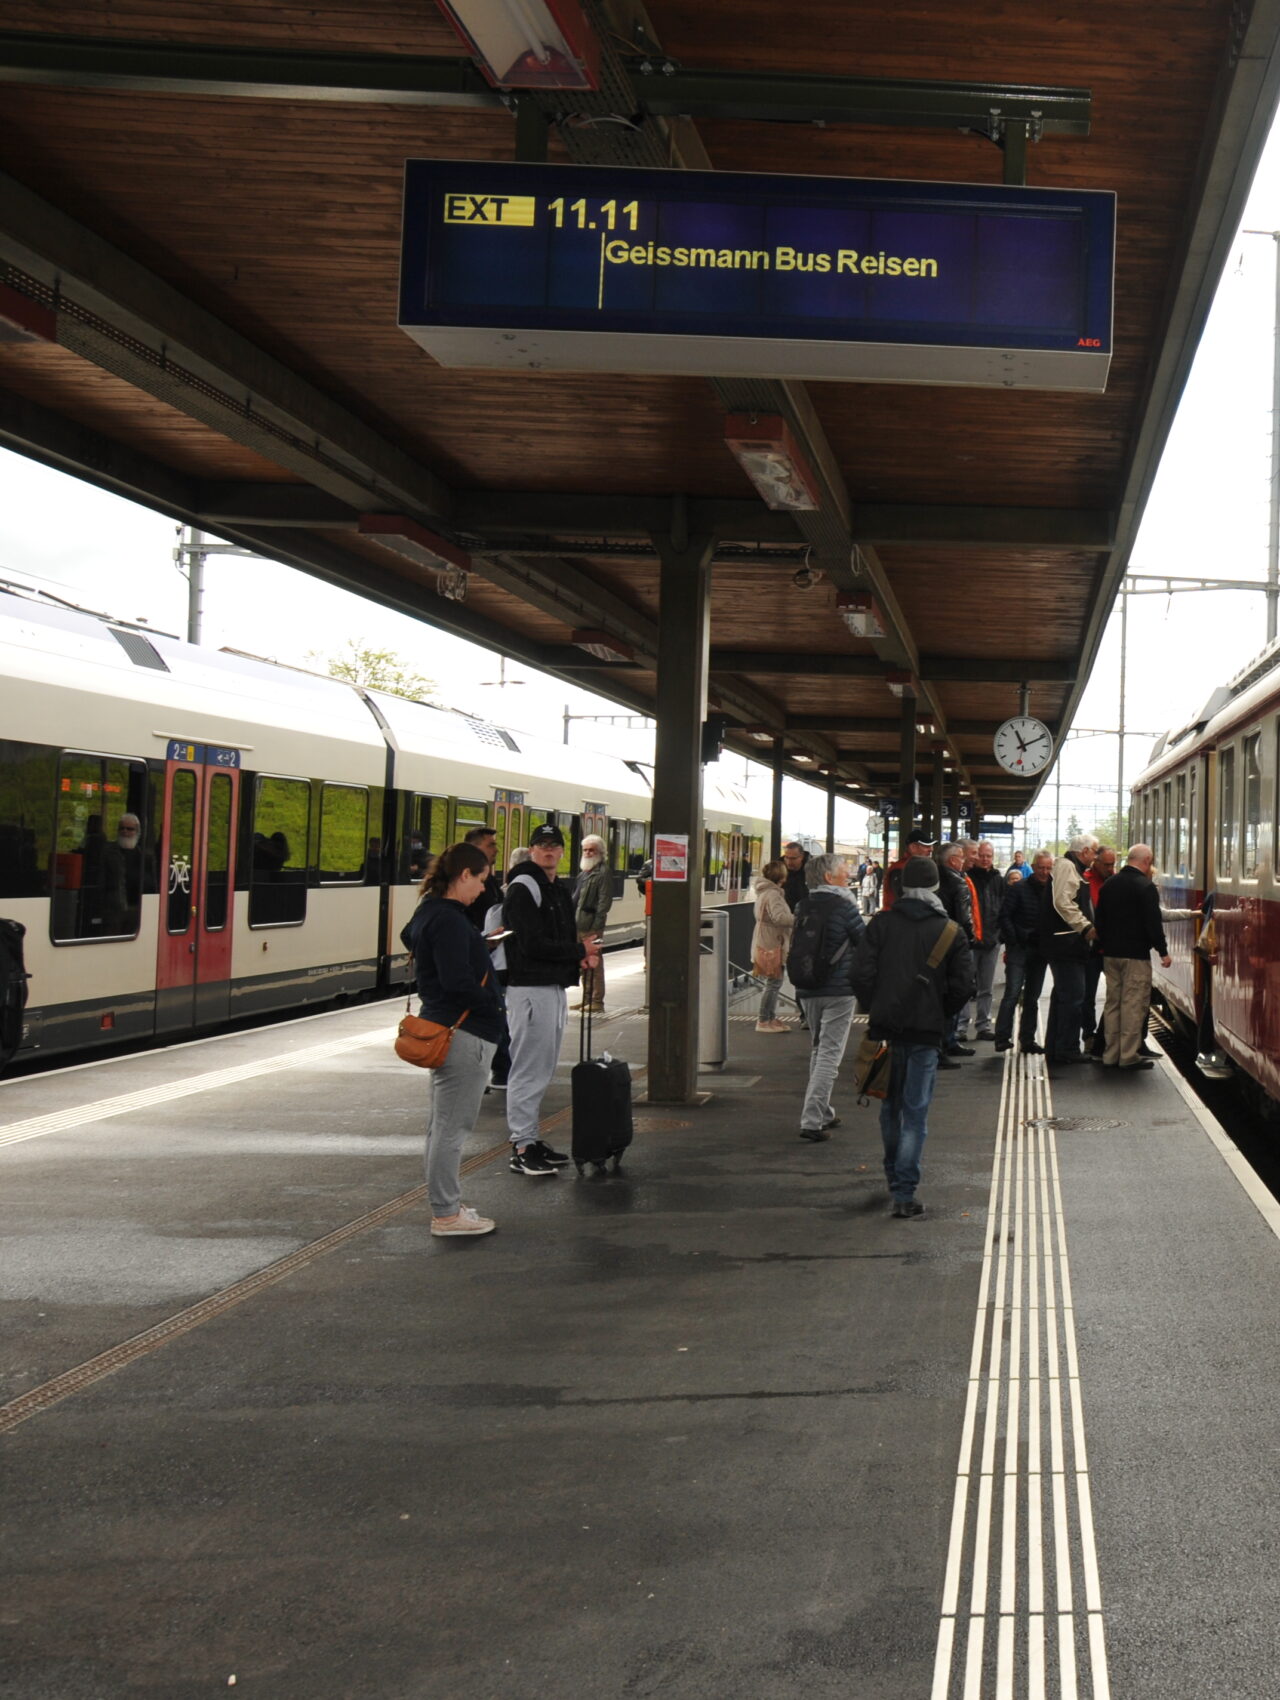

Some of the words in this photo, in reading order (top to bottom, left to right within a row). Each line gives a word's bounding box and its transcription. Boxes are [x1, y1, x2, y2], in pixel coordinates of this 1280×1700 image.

[447, 195, 509, 221] EXT
[548, 197, 639, 231] 11.11
[605, 239, 770, 270] Geissmann
[775, 246, 832, 273] Bus
[837, 249, 938, 278] Reisen
[1077, 338, 1101, 347] AEG
[173, 743, 180, 760] 2
[229, 751, 236, 767] 2
[885, 804, 893, 815] 2
[960, 806, 968, 816] 3
